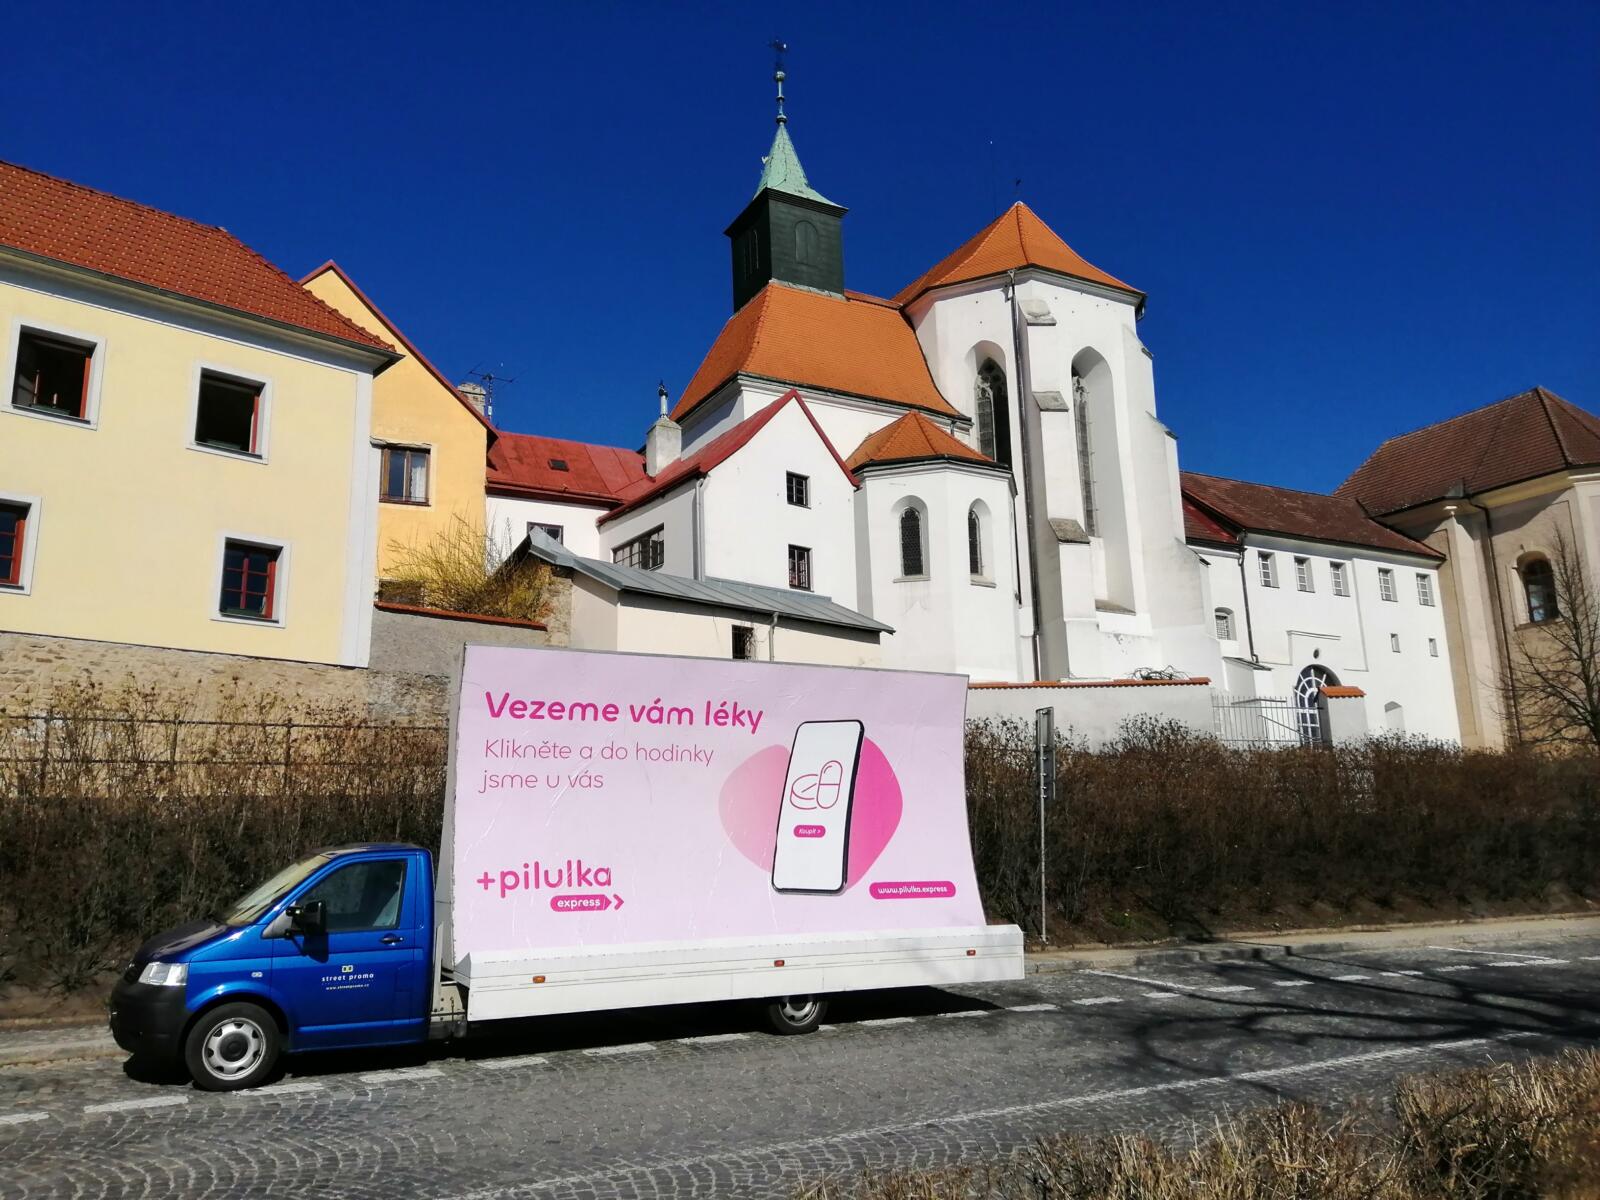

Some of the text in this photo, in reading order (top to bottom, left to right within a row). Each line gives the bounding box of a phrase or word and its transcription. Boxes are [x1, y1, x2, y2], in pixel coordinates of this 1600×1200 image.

[485, 692, 763, 734] Vezeme vám léky
[485, 738, 714, 767] Klikněte a do hodinky
[478, 769, 604, 794] jsme u vás
[877, 884, 948, 896] www.pilulka.express
[557, 897, 601, 909] express
[348, 973, 375, 981] promo
